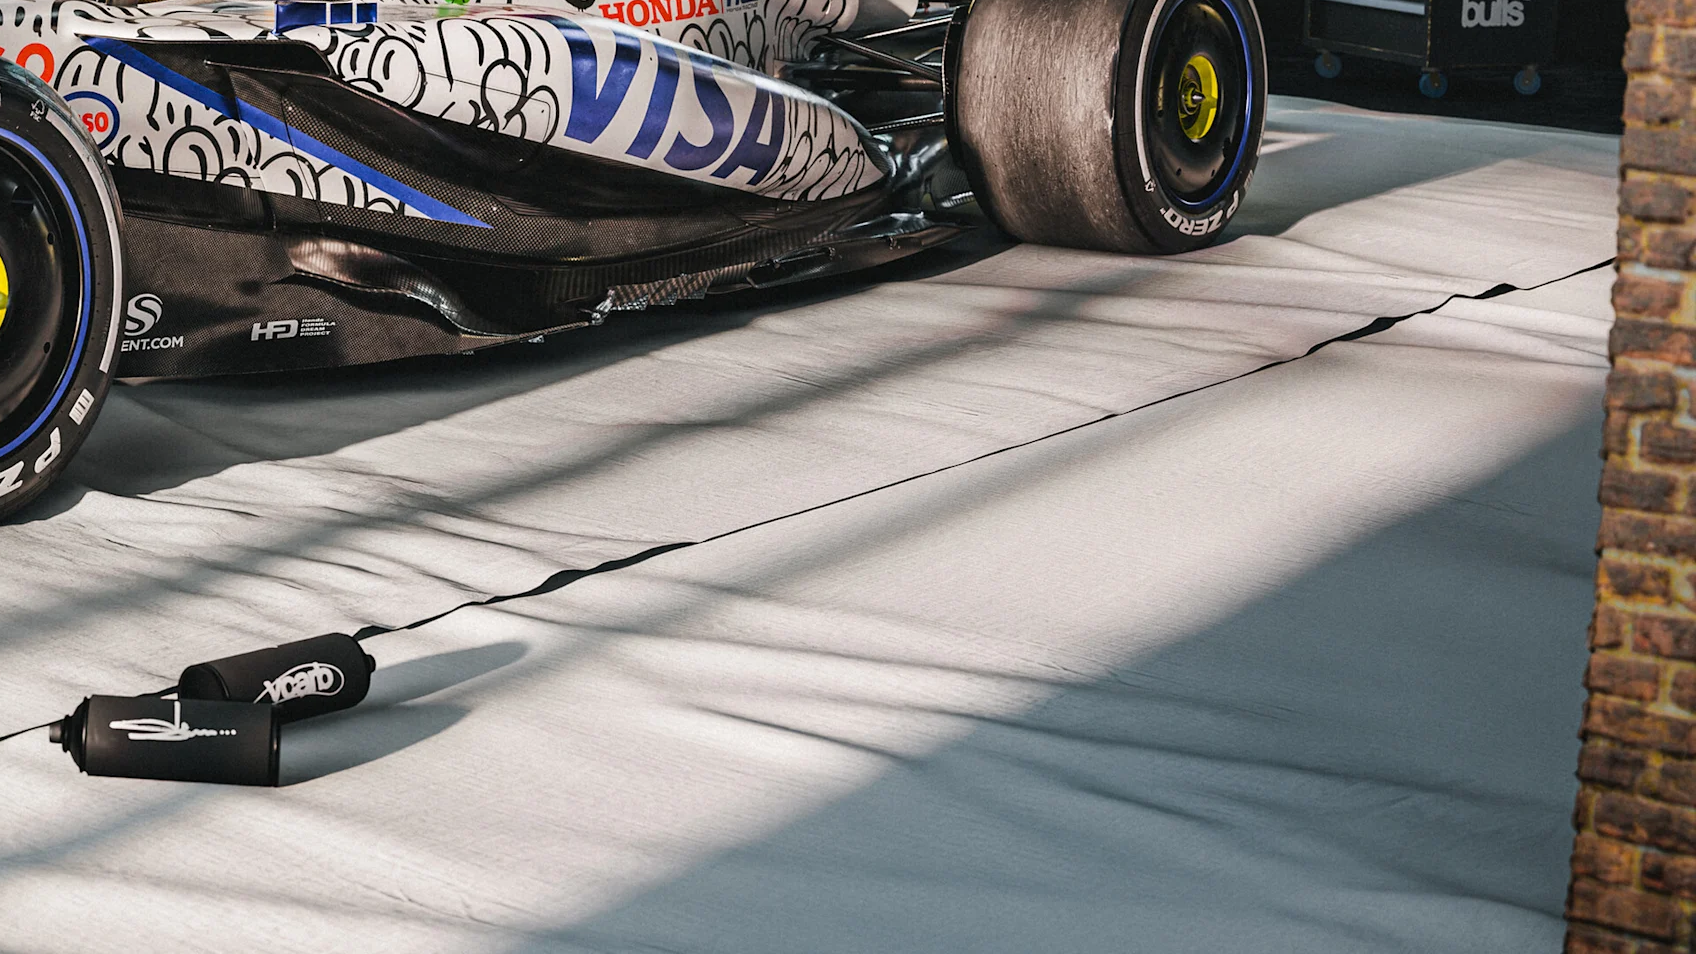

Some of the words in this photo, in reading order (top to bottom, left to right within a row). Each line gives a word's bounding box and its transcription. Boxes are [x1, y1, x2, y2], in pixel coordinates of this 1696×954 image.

[532, 12, 786, 186] VISA
[1226, 189, 1239, 219] P
[120, 335, 184, 352] ENT.COM
[33, 426, 62, 474] P
